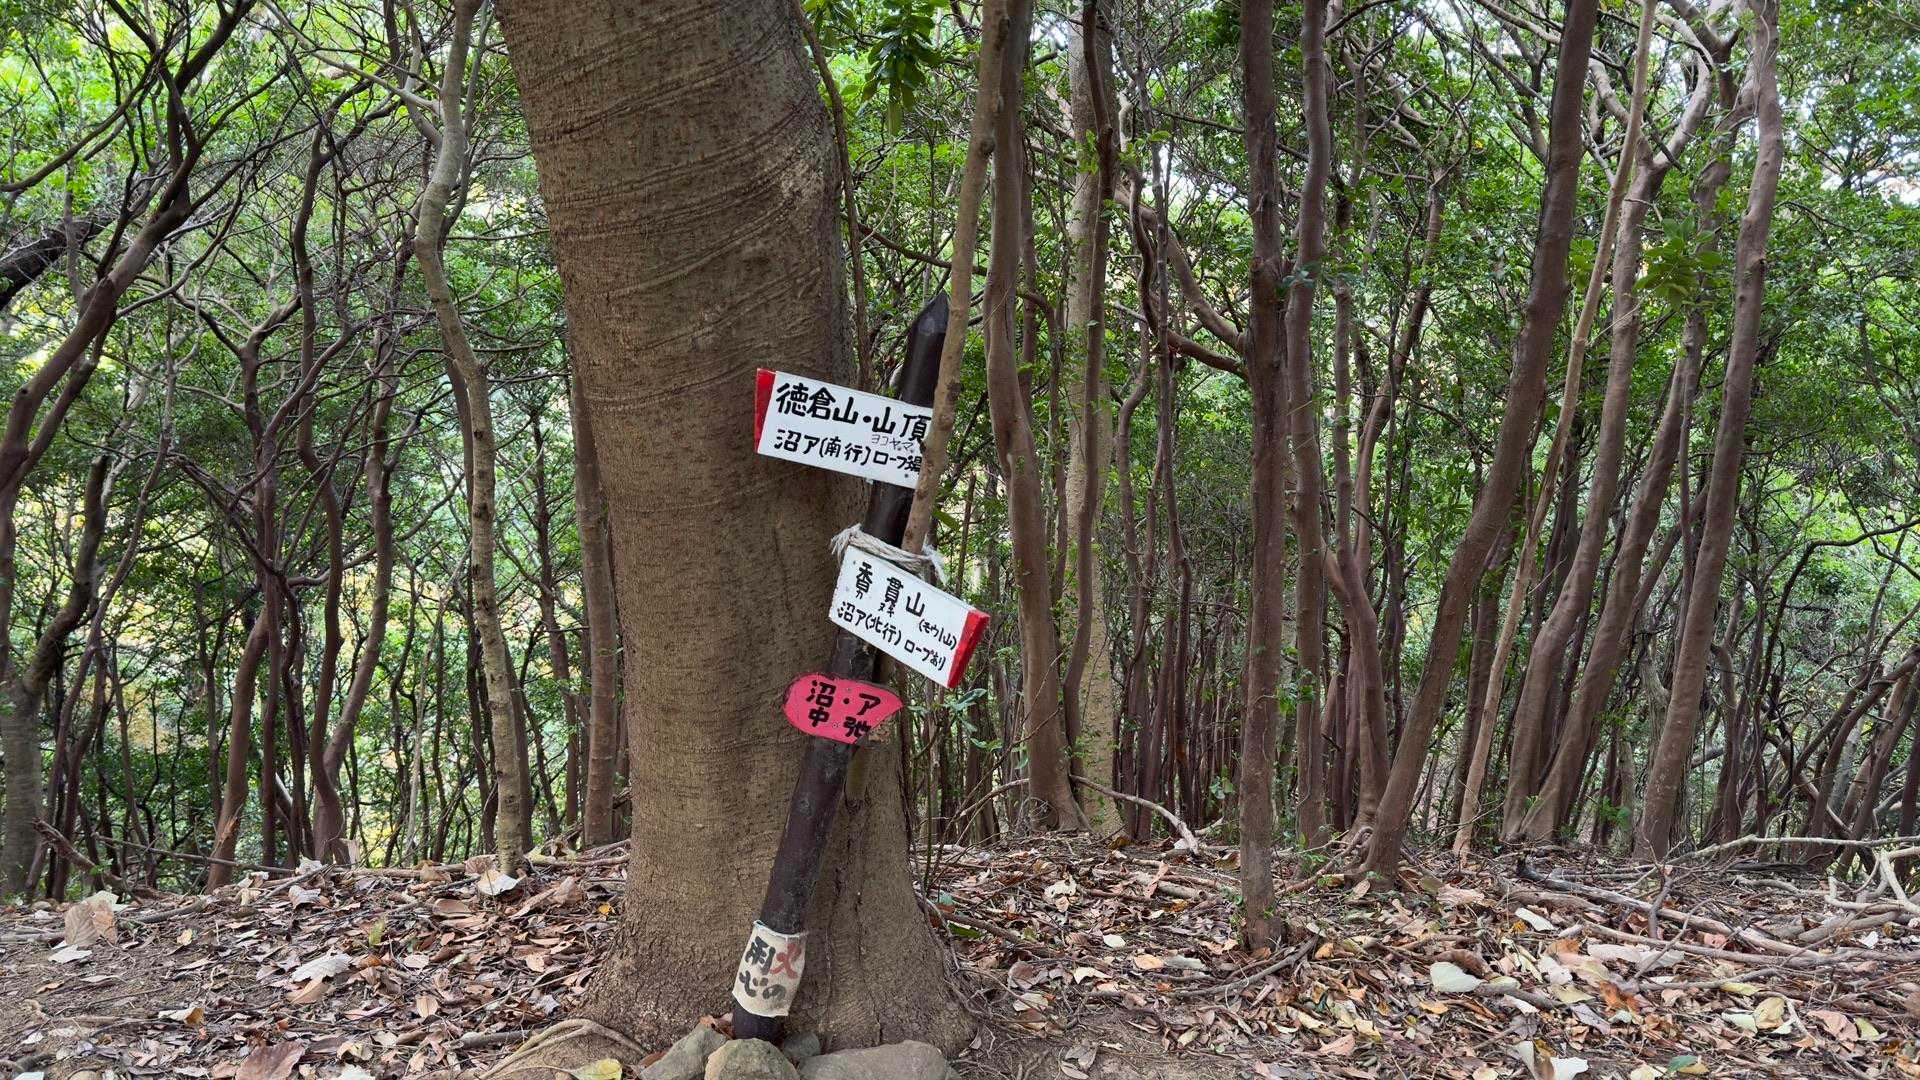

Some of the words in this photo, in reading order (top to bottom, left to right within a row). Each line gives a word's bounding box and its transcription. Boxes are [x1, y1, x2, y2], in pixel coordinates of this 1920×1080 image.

[776, 382, 932, 444] 徳倉山・山頂
[855, 561, 926, 618] 香貫山
